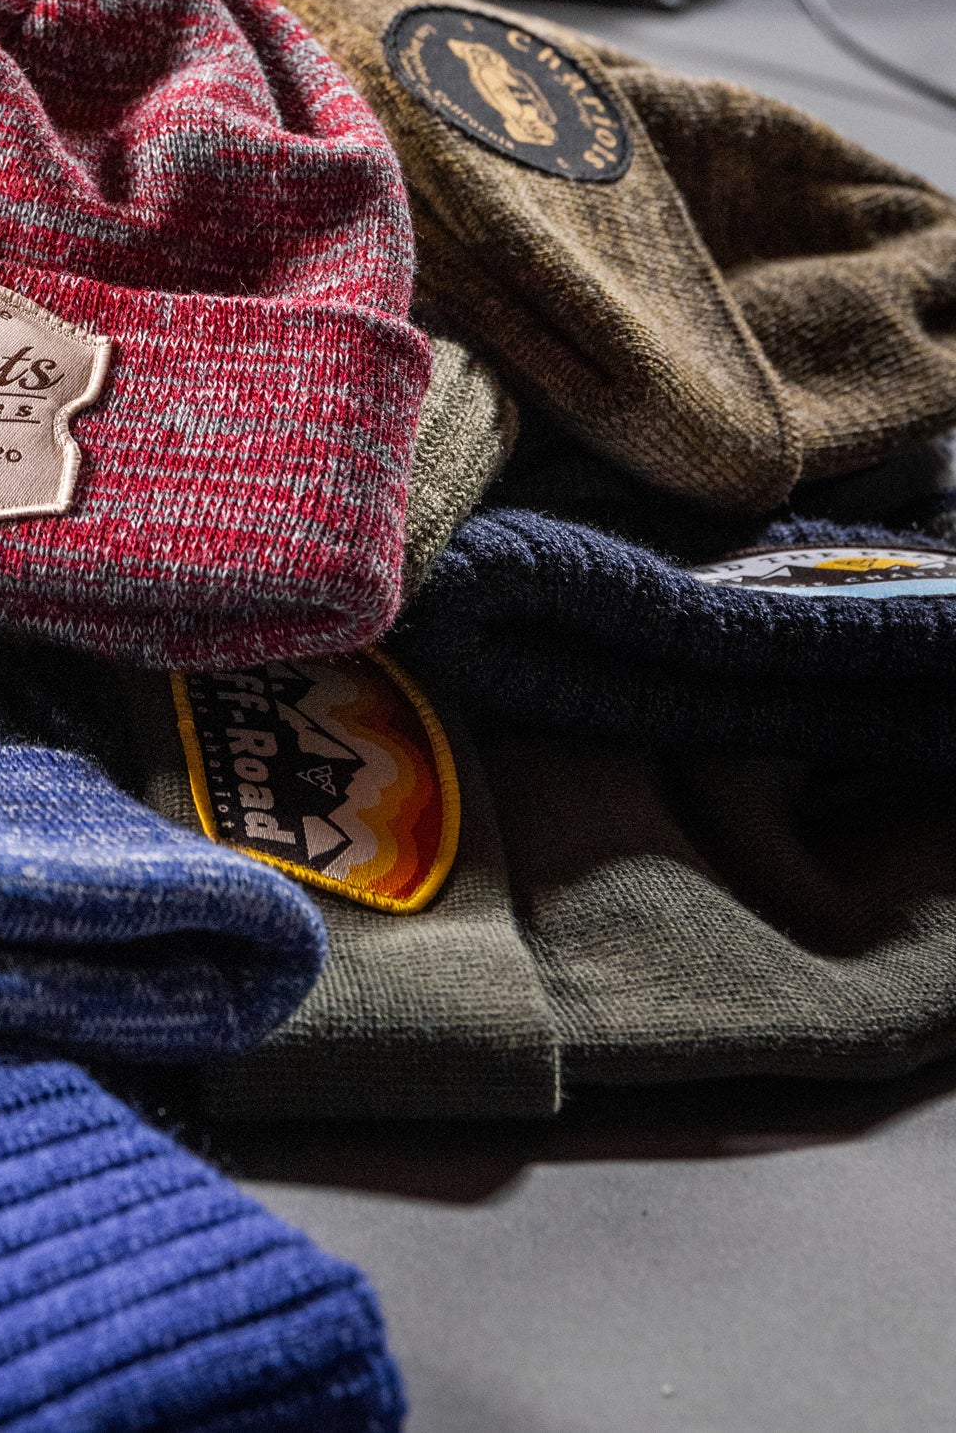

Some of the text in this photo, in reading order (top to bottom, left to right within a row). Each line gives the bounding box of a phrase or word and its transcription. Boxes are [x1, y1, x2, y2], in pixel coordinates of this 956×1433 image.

[506, 29, 620, 170] Chariots
[202, 731, 236, 843] chariot
[212, 672, 296, 844] ff-Road
